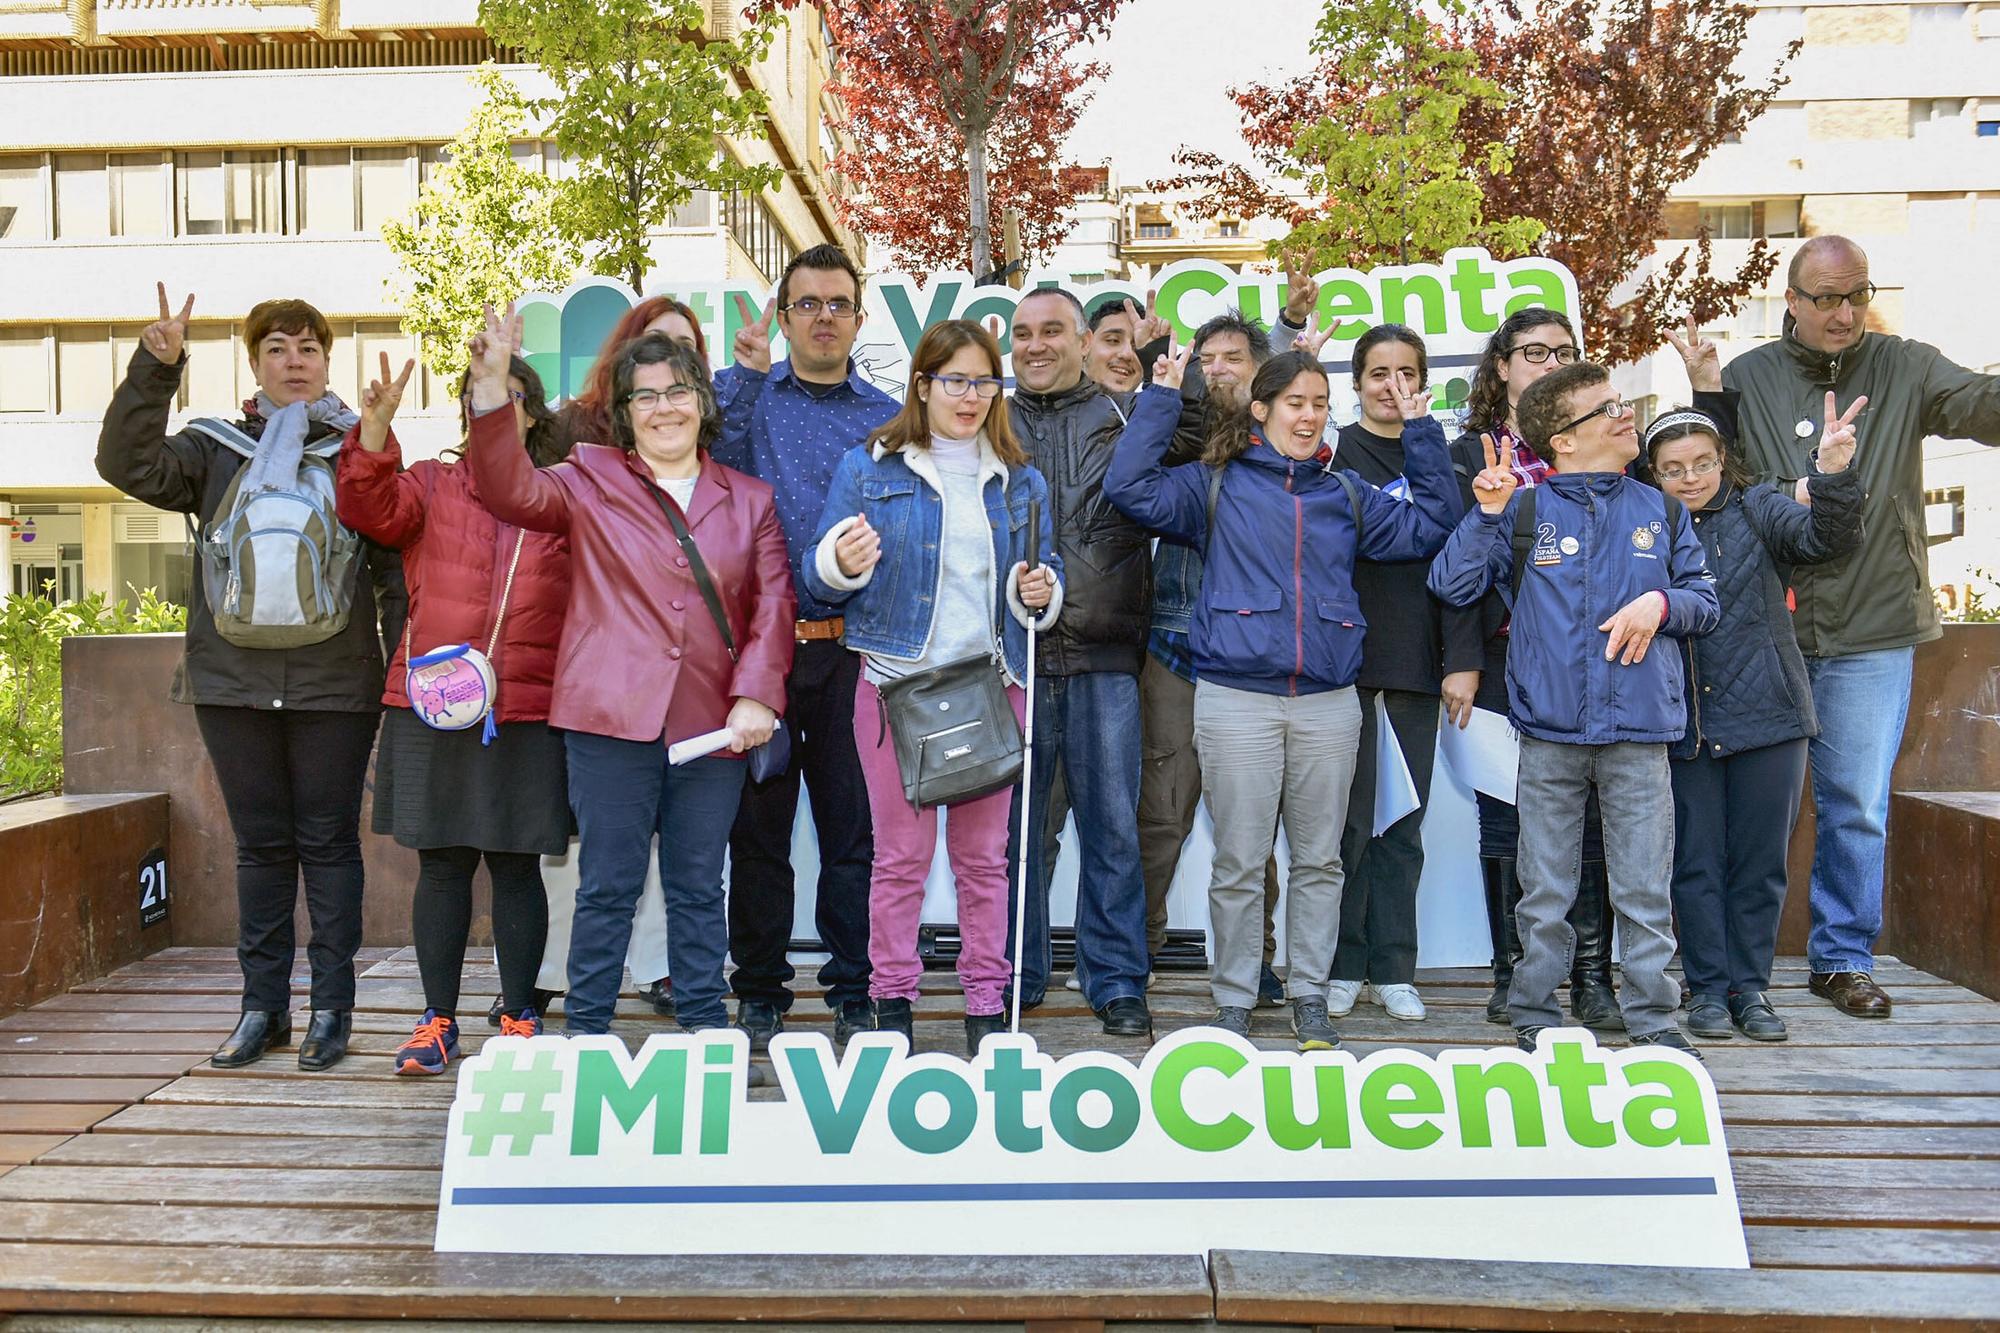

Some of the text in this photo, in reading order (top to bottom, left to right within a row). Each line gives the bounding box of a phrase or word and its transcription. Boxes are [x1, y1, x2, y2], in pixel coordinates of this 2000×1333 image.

[879, 258, 1568, 358] VoCuenta
[1538, 522, 1556, 549] 2
[140, 860, 166, 910] 21
[462, 1043, 734, 1157] #Mi
